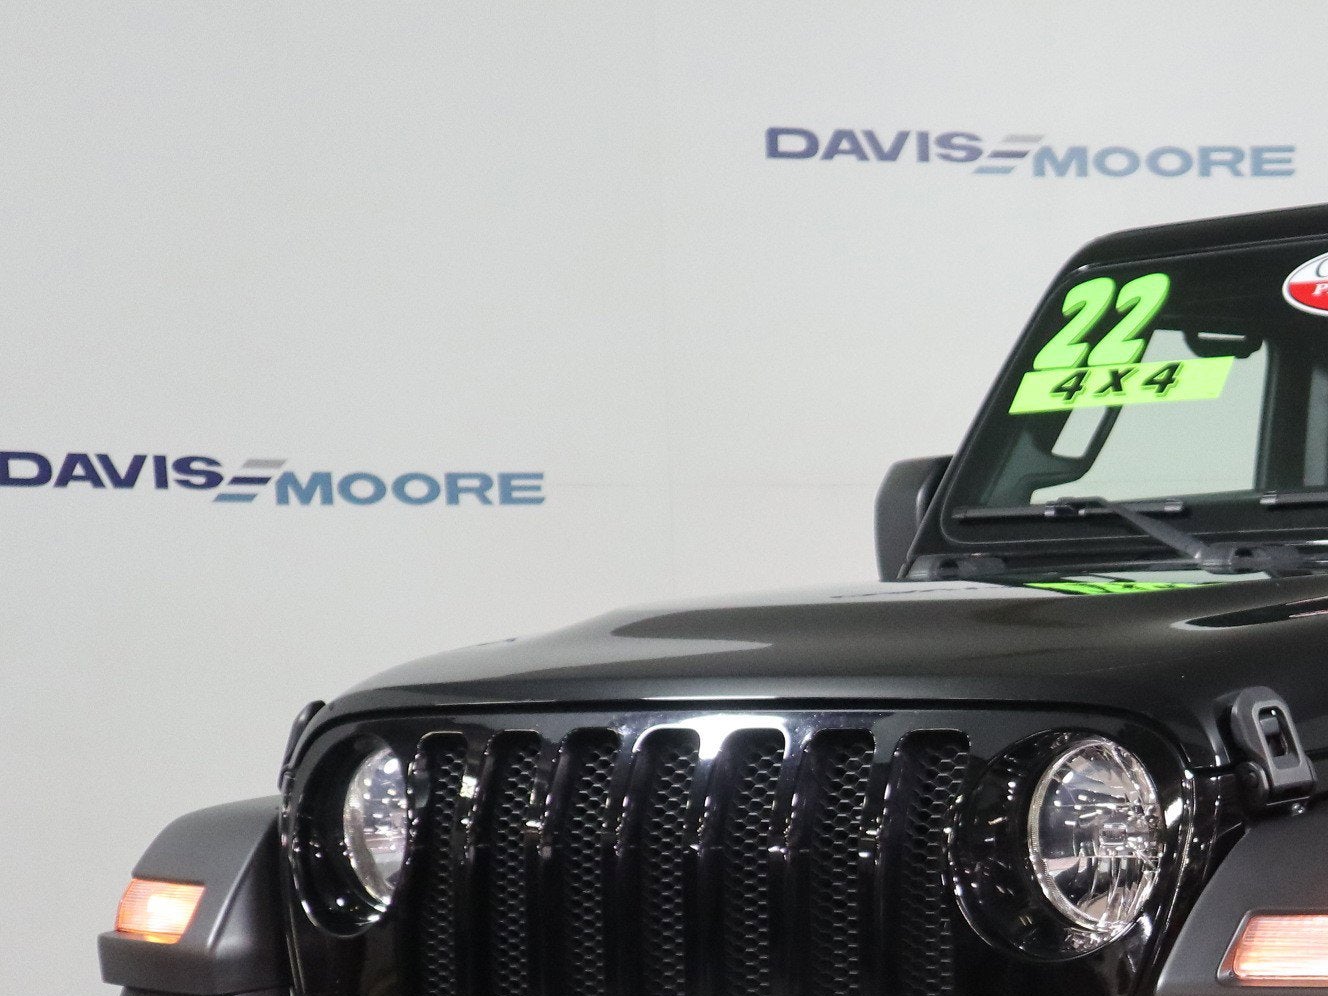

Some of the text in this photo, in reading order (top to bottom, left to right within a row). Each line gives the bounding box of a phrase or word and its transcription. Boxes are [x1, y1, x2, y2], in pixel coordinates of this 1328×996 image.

[764, 126, 1297, 178] DAVIS MOORE
[1032, 272, 1171, 371] 22
[0, 450, 546, 506] DAVIS MOORE
